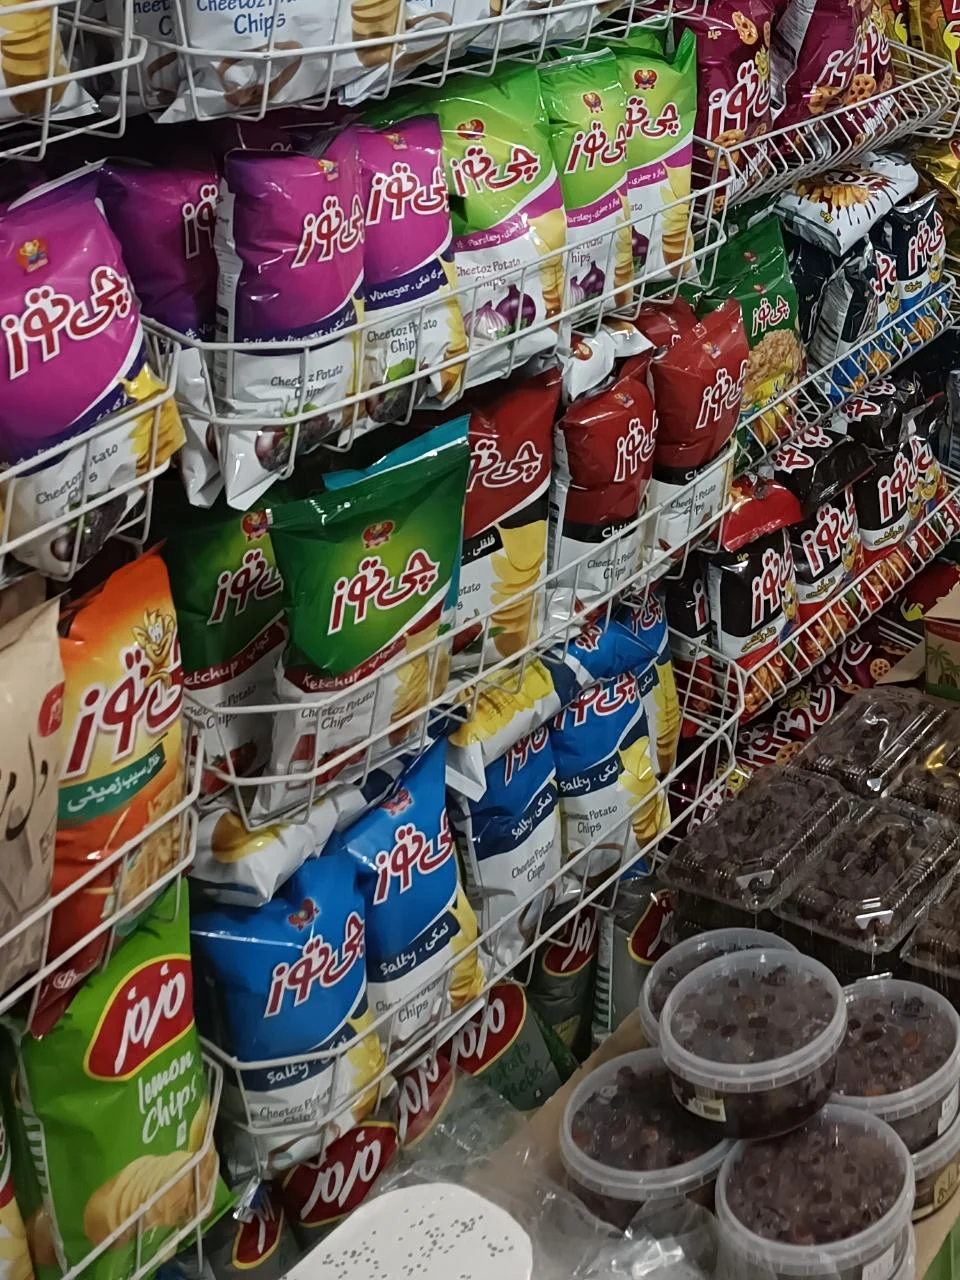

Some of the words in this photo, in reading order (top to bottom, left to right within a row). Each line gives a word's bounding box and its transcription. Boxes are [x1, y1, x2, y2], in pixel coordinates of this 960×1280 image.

[571, 252, 591, 265] hips
[369, 282, 410, 303] Vinegar
[458, 582, 482, 598] otato
[183, 661, 238, 686] etchup
[560, 776, 592, 795] Salty
[380, 950, 417, 976] Salty
